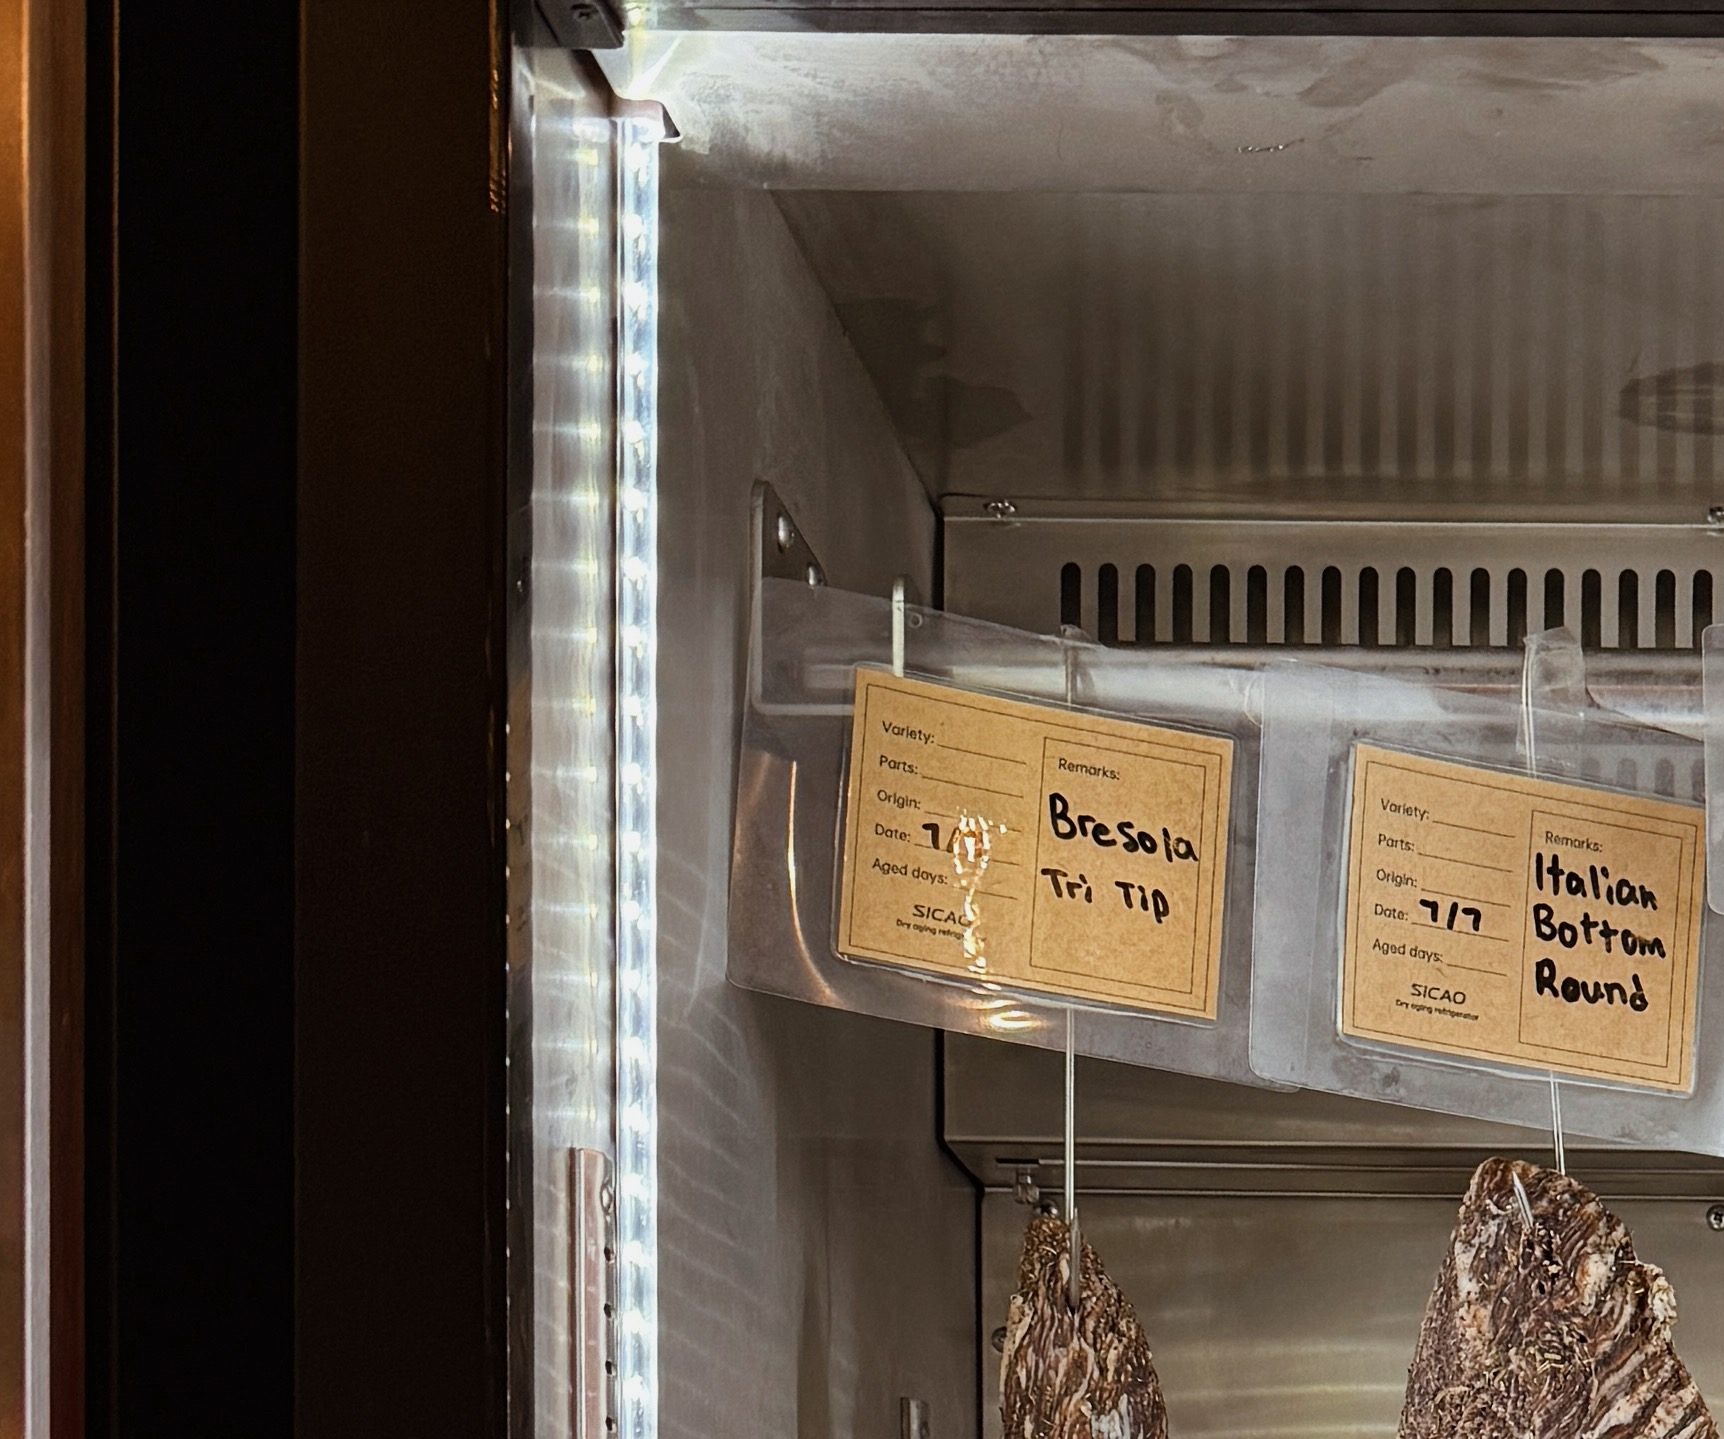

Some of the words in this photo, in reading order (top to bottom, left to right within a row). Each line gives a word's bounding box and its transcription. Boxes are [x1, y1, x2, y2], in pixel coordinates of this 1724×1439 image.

[882, 720, 935, 744] Variety:
[879, 755, 918, 775] Parts:
[1058, 758, 1120, 780] Remarks:
[877, 789, 921, 810] Origin:
[1381, 798, 1429, 821] Variety:
[875, 823, 911, 842] Date:
[1049, 792, 1199, 863] Bresola
[1378, 833, 1415, 851] Parts:
[1545, 831, 1603, 852] Remarks:
[872, 858, 908, 877] Aged
[912, 867, 948, 884] days:
[1376, 868, 1417, 888] Origin:
[1535, 852, 1658, 911] Italian
[1041, 868, 1092, 903] Tri
[1114, 881, 1170, 924] Tip
[1374, 903, 1408, 921] Date:
[1419, 898, 1482, 931] 7/7
[1533, 903, 1666, 959] Bottom
[1372, 938, 1406, 956] Aged
[1409, 946, 1443, 963] days:
[1411, 983, 1467, 1005] SICAO
[1535, 958, 1649, 1012] Round
